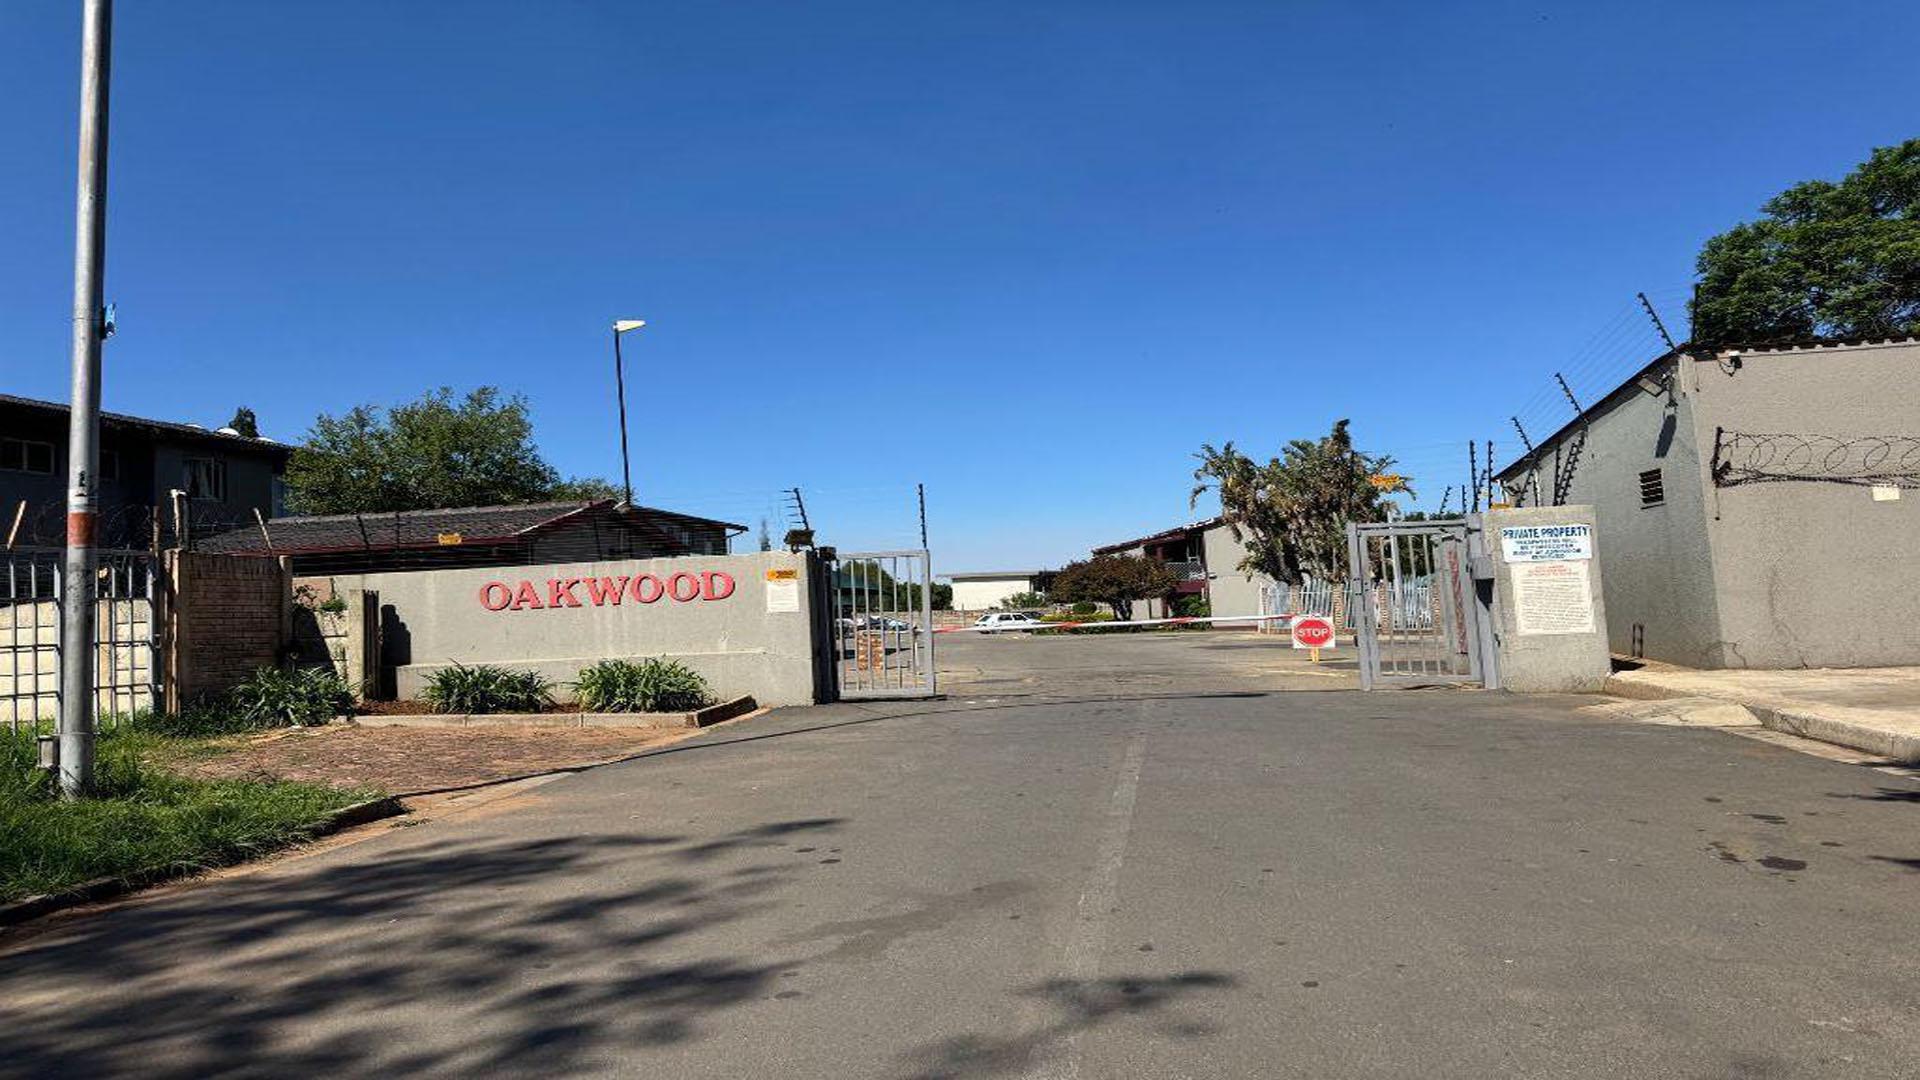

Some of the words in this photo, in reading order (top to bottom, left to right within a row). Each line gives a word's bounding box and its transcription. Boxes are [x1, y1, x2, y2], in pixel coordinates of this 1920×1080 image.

[1503, 528, 1540, 539] PRIVATE
[1541, 526, 1587, 538] PROPERTY
[479, 570, 736, 611] OAKWOOD
[1297, 627, 1329, 639] STOP
